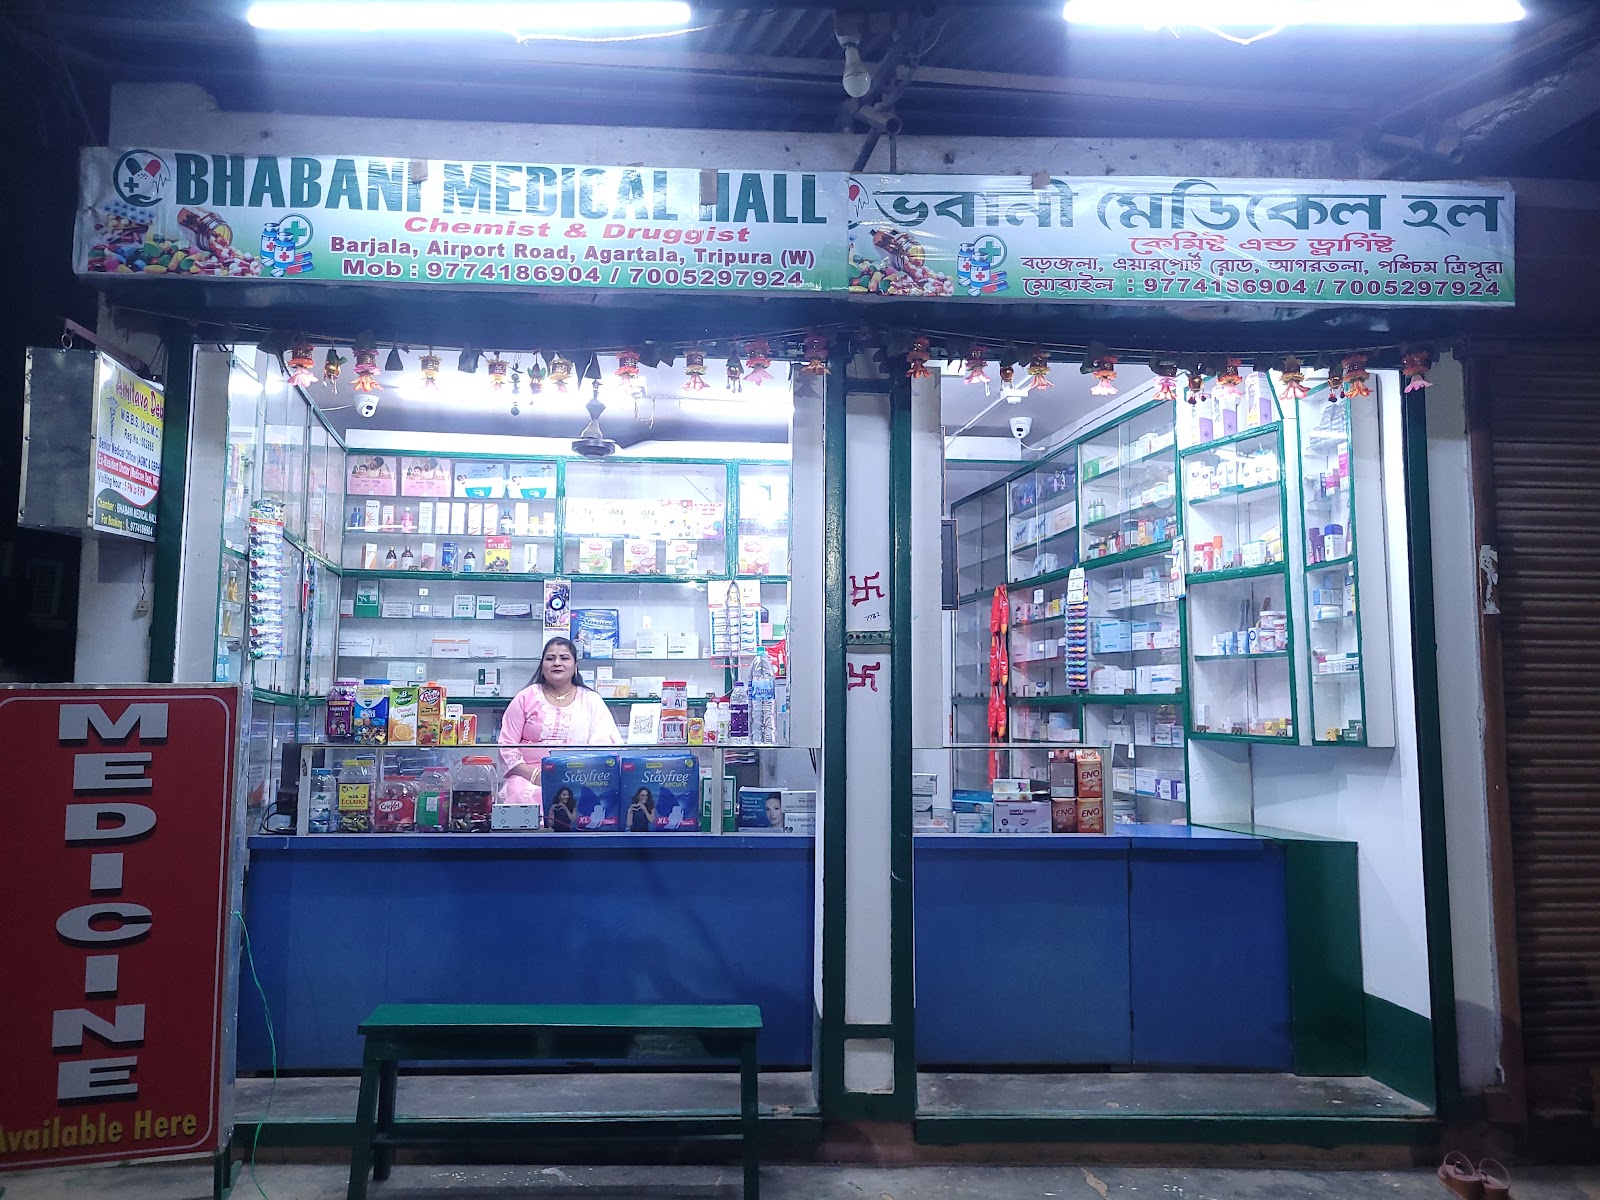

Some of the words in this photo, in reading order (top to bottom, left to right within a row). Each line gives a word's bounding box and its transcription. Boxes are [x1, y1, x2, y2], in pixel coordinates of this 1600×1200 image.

[175, 153, 421, 212] BHABANI
[443, 162, 678, 220] MEDICAL
[873, 178, 1077, 227] ভবানী
[1097, 178, 1386, 233] মেডিকেল
[1402, 194, 1504, 236] হল
[404, 216, 550, 238] Chemist
[564, 223, 586, 238] &
[603, 223, 750, 244] Druggist
[331, 237, 418, 257] Barjala,
[427, 241, 506, 258] Airport
[514, 243, 576, 261] Road,
[585, 245, 686, 265] Agartala,
[694, 249, 772, 267] Tripura
[780, 250, 815, 269] (W)
[1239, 238, 1297, 252] এন্ড
[343, 260, 401, 276] Mob
[427, 261, 600, 283] 9774186904
[631, 268, 803, 288] 7005297924
[1210, 258, 1259, 276] রোড,
[1267, 258, 1369, 275] আগরতলা,
[1378, 253, 1438, 275] পশ্চিম
[1444, 255, 1503, 282] ত্রিপুরা
[1023, 275, 1114, 296] মোবাইল
[1144, 277, 1307, 294] 9774186904
[1333, 280, 1500, 295] 7005297924
[562, 769, 610, 785] Stayfree
[641, 769, 690, 785] Stayfree
[1081, 769, 1100, 779] ENO
[578, 816, 590, 824] XL
[656, 817, 668, 825] XL
[1055, 807, 1075, 817] ENO
[1081, 807, 1100, 818] ENO
[52, 703, 169, 1100] MEDICINE
[134, 1109, 197, 1141] Here
